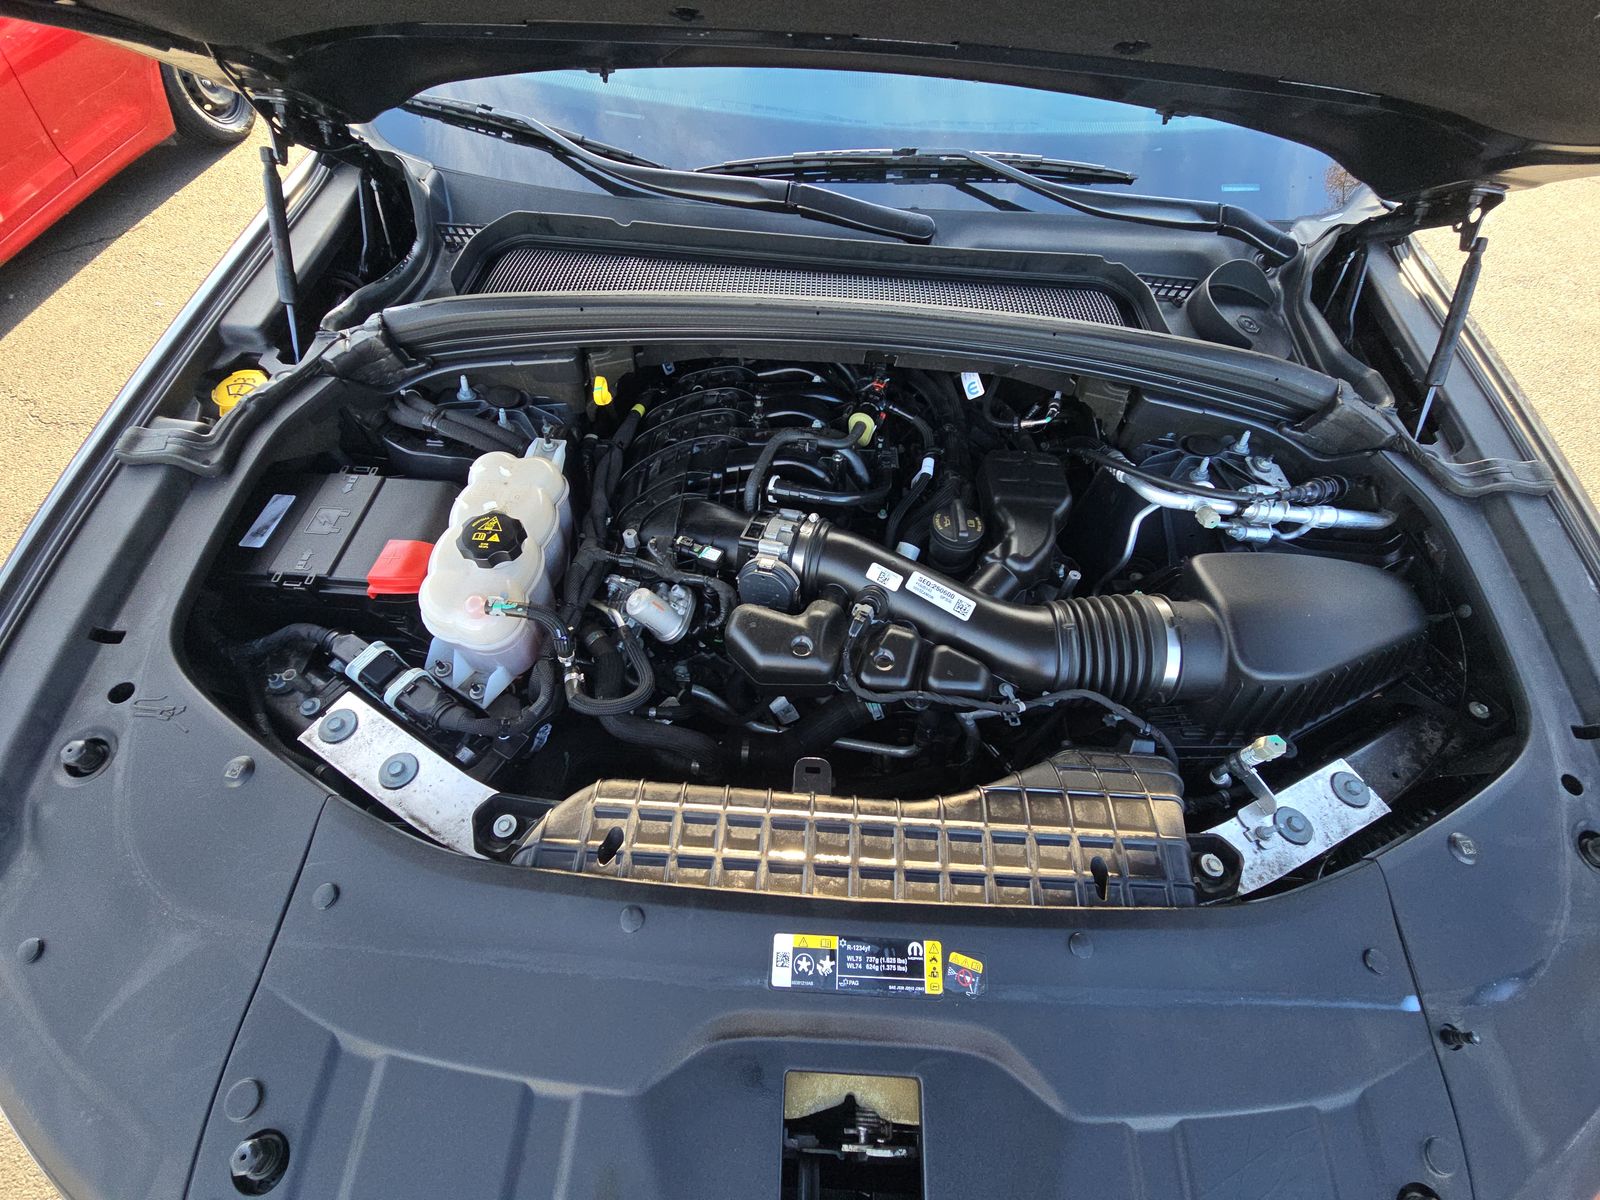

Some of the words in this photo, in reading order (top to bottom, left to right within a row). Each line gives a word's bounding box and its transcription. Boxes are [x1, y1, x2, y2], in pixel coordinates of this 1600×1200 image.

[846, 945, 871, 953] R-1234yf
[866, 956, 879, 964] 737g
[897, 957, 908, 965] lbs)
[897, 965, 908, 973] lbs)
